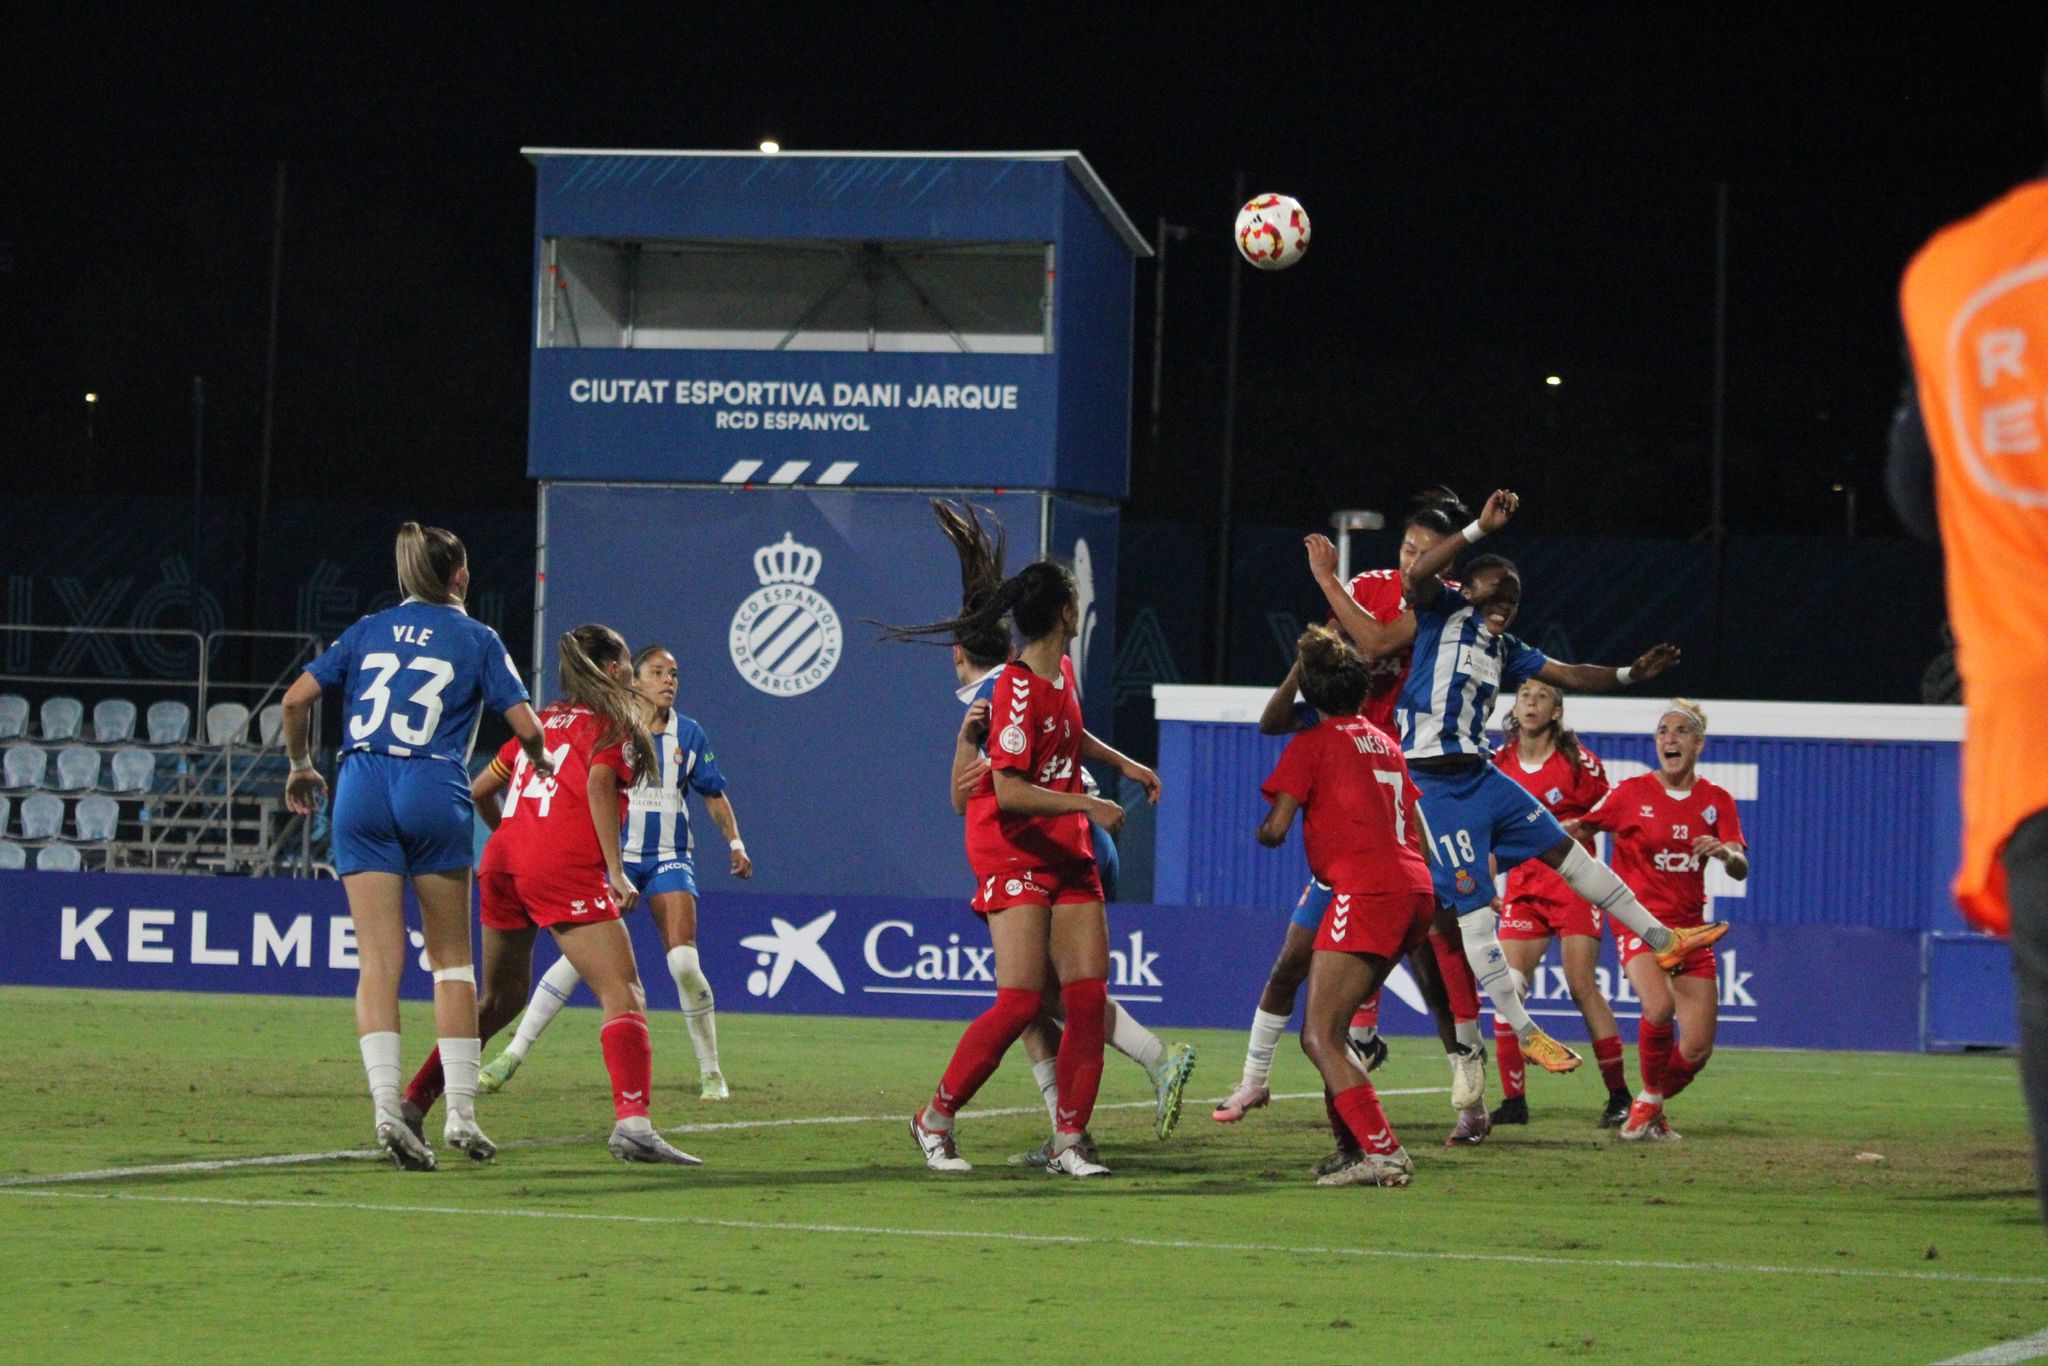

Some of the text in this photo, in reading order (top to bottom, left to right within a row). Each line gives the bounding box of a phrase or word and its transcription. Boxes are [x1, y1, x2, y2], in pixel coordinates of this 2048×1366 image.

[570, 379, 1018, 410] CIUTAT ESPORTIVA DANI JARQUE
[716, 411, 870, 432] RCD ESPANYOL
[735, 588, 837, 635] RCD ESPANYOL
[735, 646, 837, 692] DE BARCELONA
[349, 652, 455, 746] 33
[501, 743, 571, 819] 14
[1372, 768, 1407, 846] 7
[1439, 828, 1476, 869] 18
[1672, 824, 1689, 840] 23
[60, 906, 361, 970] KELME
